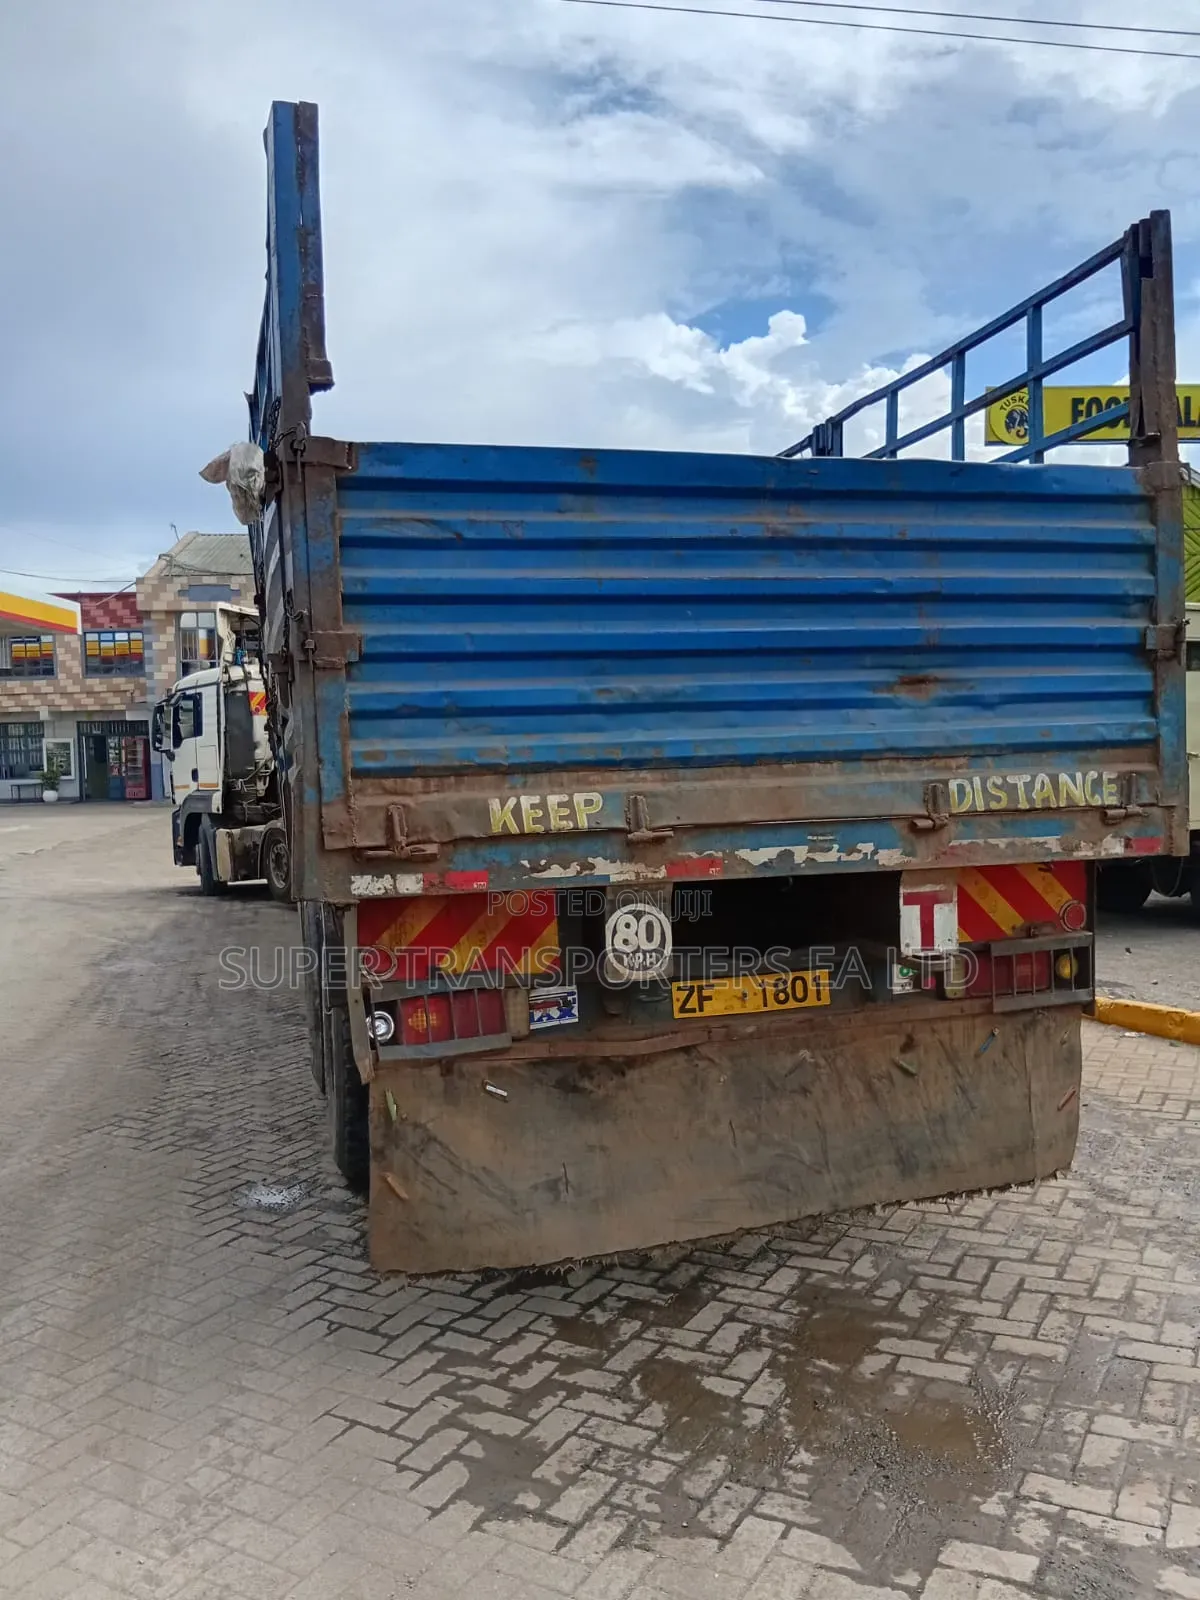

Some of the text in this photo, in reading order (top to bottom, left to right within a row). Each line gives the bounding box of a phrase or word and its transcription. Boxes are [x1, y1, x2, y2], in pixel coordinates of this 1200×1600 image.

[1000, 395, 1029, 412] TUSK
[488, 770, 1119, 834] KEEP DISTANCE
[613, 914, 661, 953] 80
[903, 890, 953, 951] T
[676, 974, 822, 1014] ZF 1801
